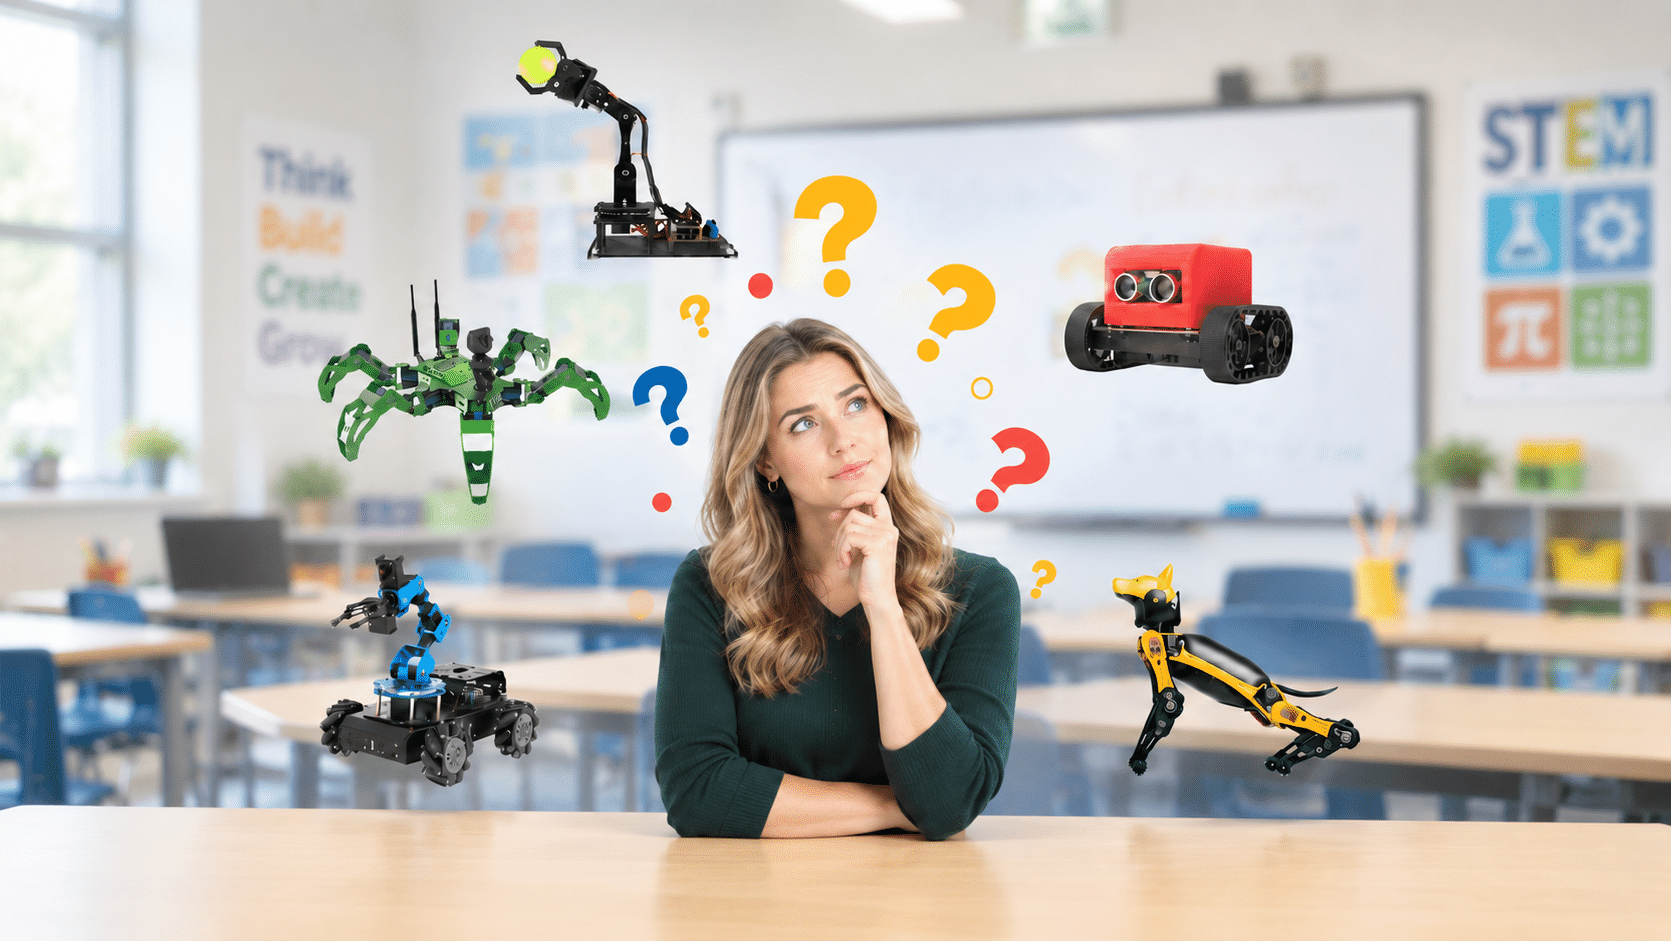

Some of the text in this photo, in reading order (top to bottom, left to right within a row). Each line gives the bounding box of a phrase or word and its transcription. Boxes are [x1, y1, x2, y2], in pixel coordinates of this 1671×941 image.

[1482, 92, 1654, 175] STEM
[257, 144, 354, 203] Think
[258, 204, 346, 257] Build
